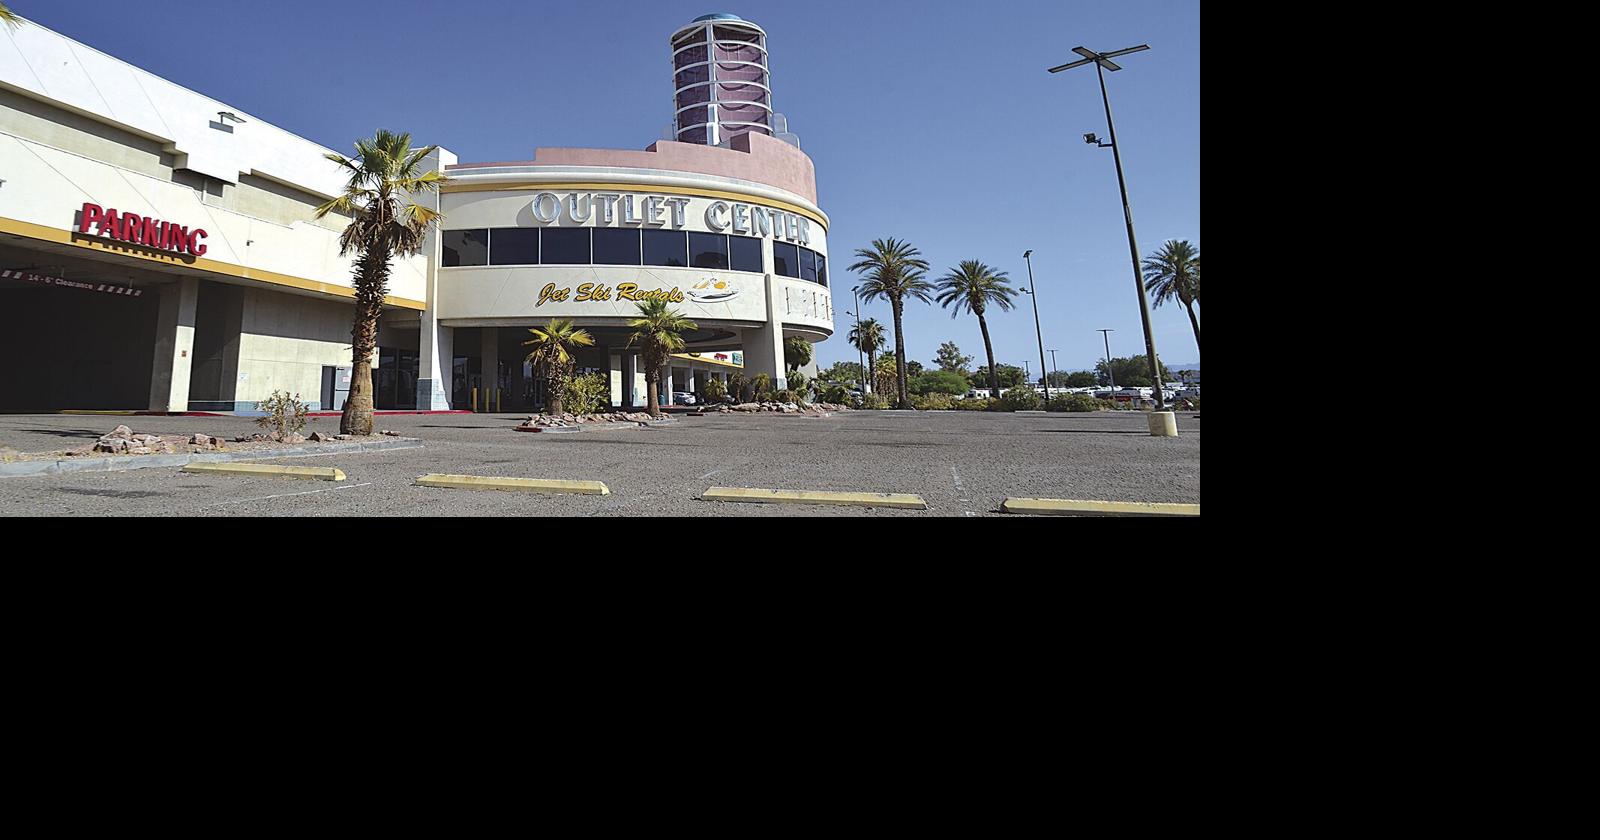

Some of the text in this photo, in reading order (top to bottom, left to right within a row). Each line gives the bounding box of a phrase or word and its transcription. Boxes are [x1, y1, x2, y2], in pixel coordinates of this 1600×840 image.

[79, 202, 208, 256] PARKING
[531, 192, 810, 246] OUTLET CENTER
[55, 278, 93, 290] Clearance
[535, 282, 685, 306] Jet Ski Rentals
